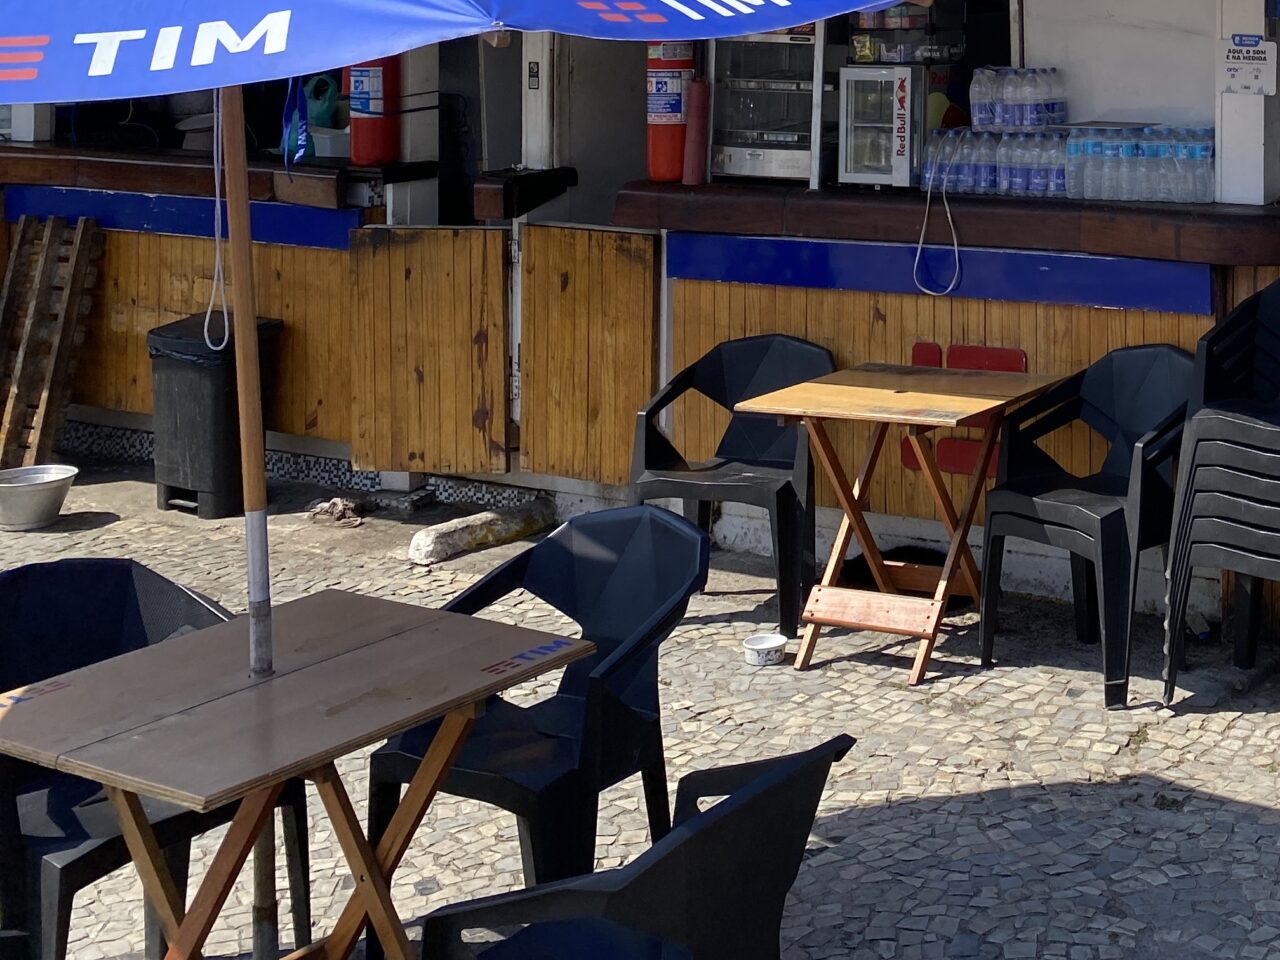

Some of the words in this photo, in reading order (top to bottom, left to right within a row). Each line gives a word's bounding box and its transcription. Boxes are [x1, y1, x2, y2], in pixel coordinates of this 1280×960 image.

[72, 8, 293, 77] TIM
[896, 112, 907, 135] Bull
[896, 135, 907, 157] Red
[511, 639, 574, 661] TIM
